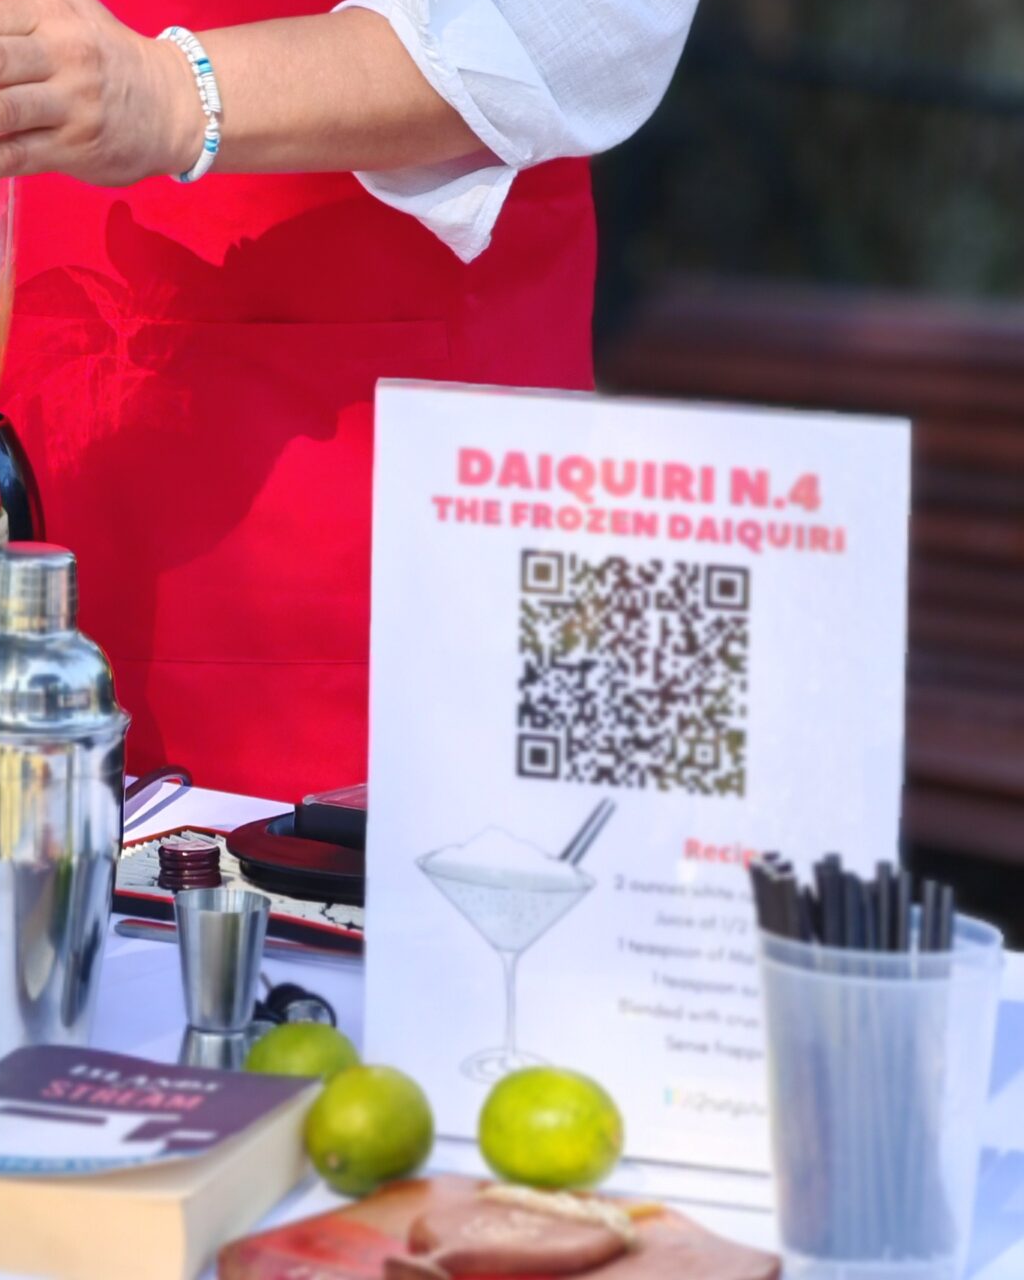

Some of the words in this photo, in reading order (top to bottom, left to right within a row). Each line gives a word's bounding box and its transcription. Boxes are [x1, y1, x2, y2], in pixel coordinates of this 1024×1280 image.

[456, 447, 716, 505] DAIQUIRI
[729, 467, 822, 513] N.4
[431, 496, 502, 526] THE
[510, 501, 658, 539] FROZEN
[667, 515, 847, 555] DAIQUIRI
[40, 1078, 205, 1111] STREAM
